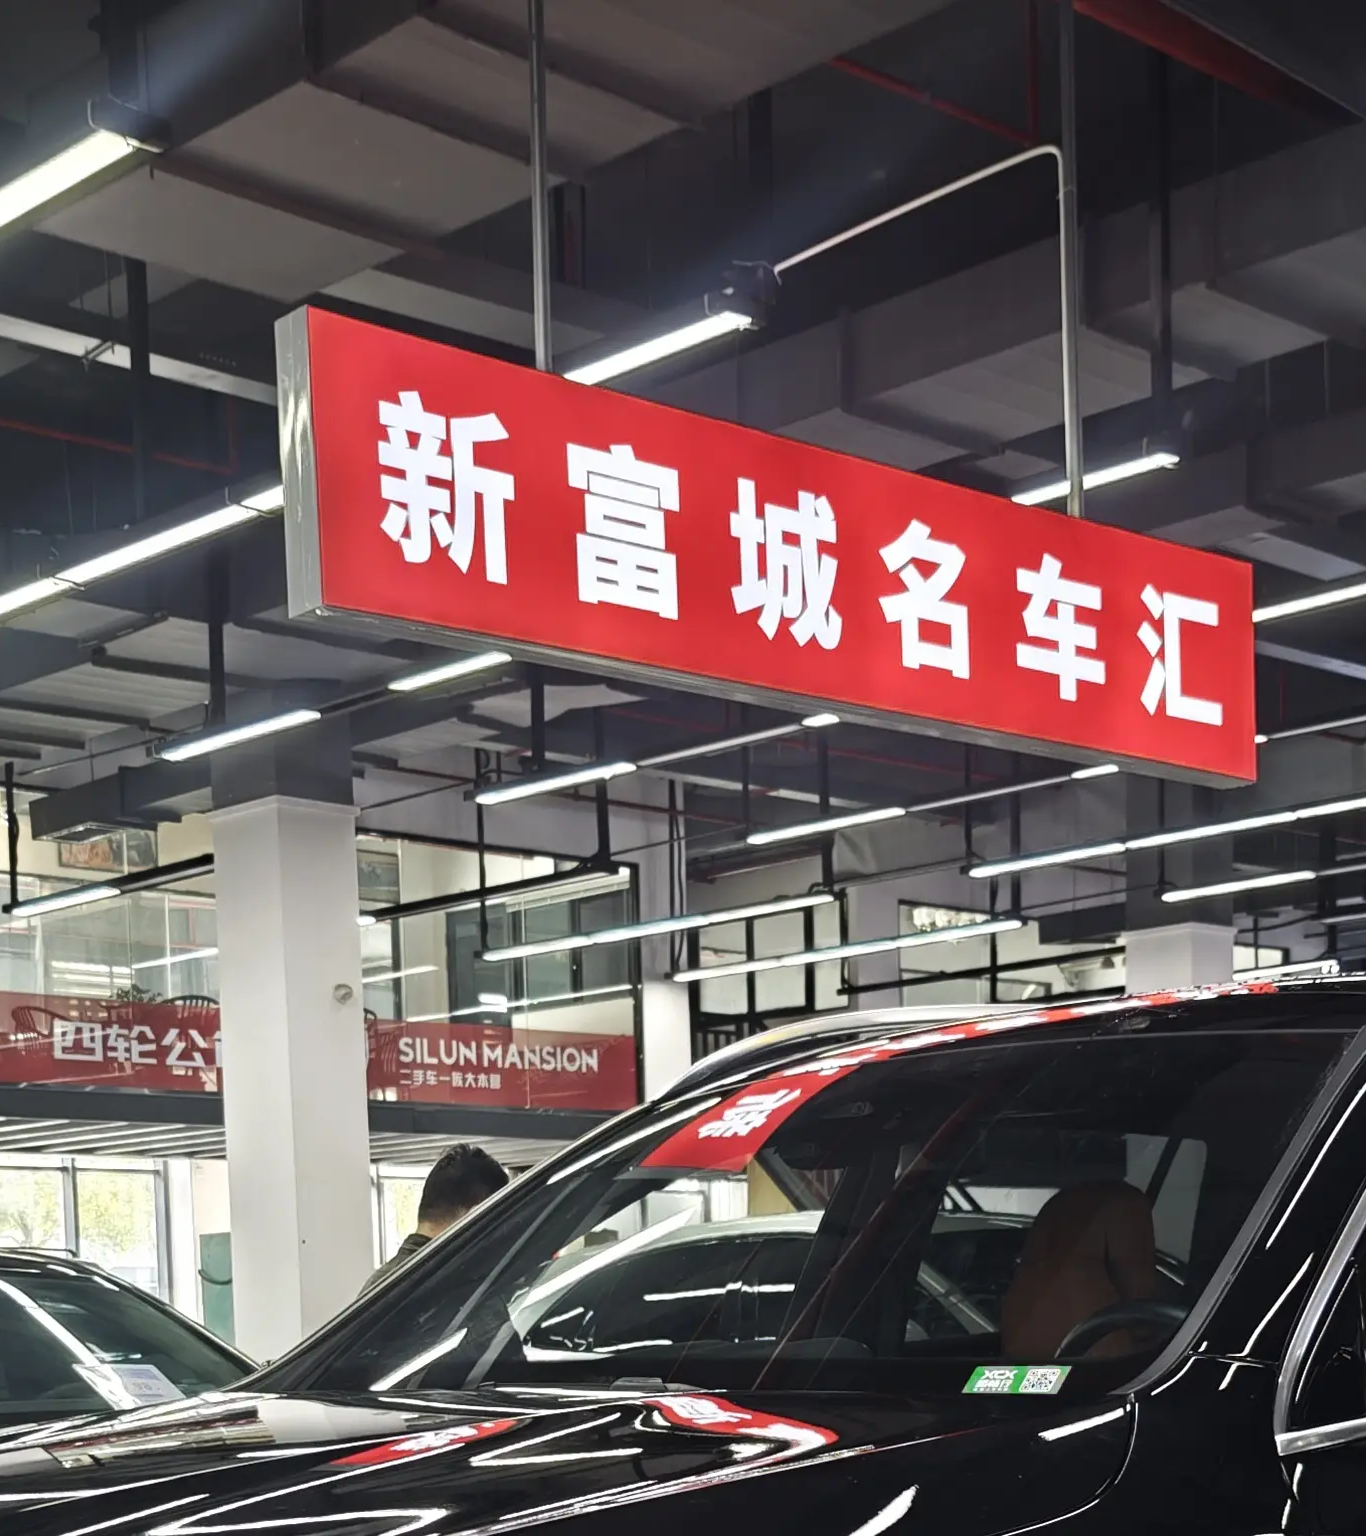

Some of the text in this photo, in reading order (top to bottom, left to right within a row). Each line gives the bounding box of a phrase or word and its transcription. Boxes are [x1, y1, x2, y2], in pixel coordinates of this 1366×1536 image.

[377, 389, 1223, 726] 新富城名车汇
[53, 1017, 223, 1068] 四轮公
[398, 1036, 599, 1073] SILUN MANSION
